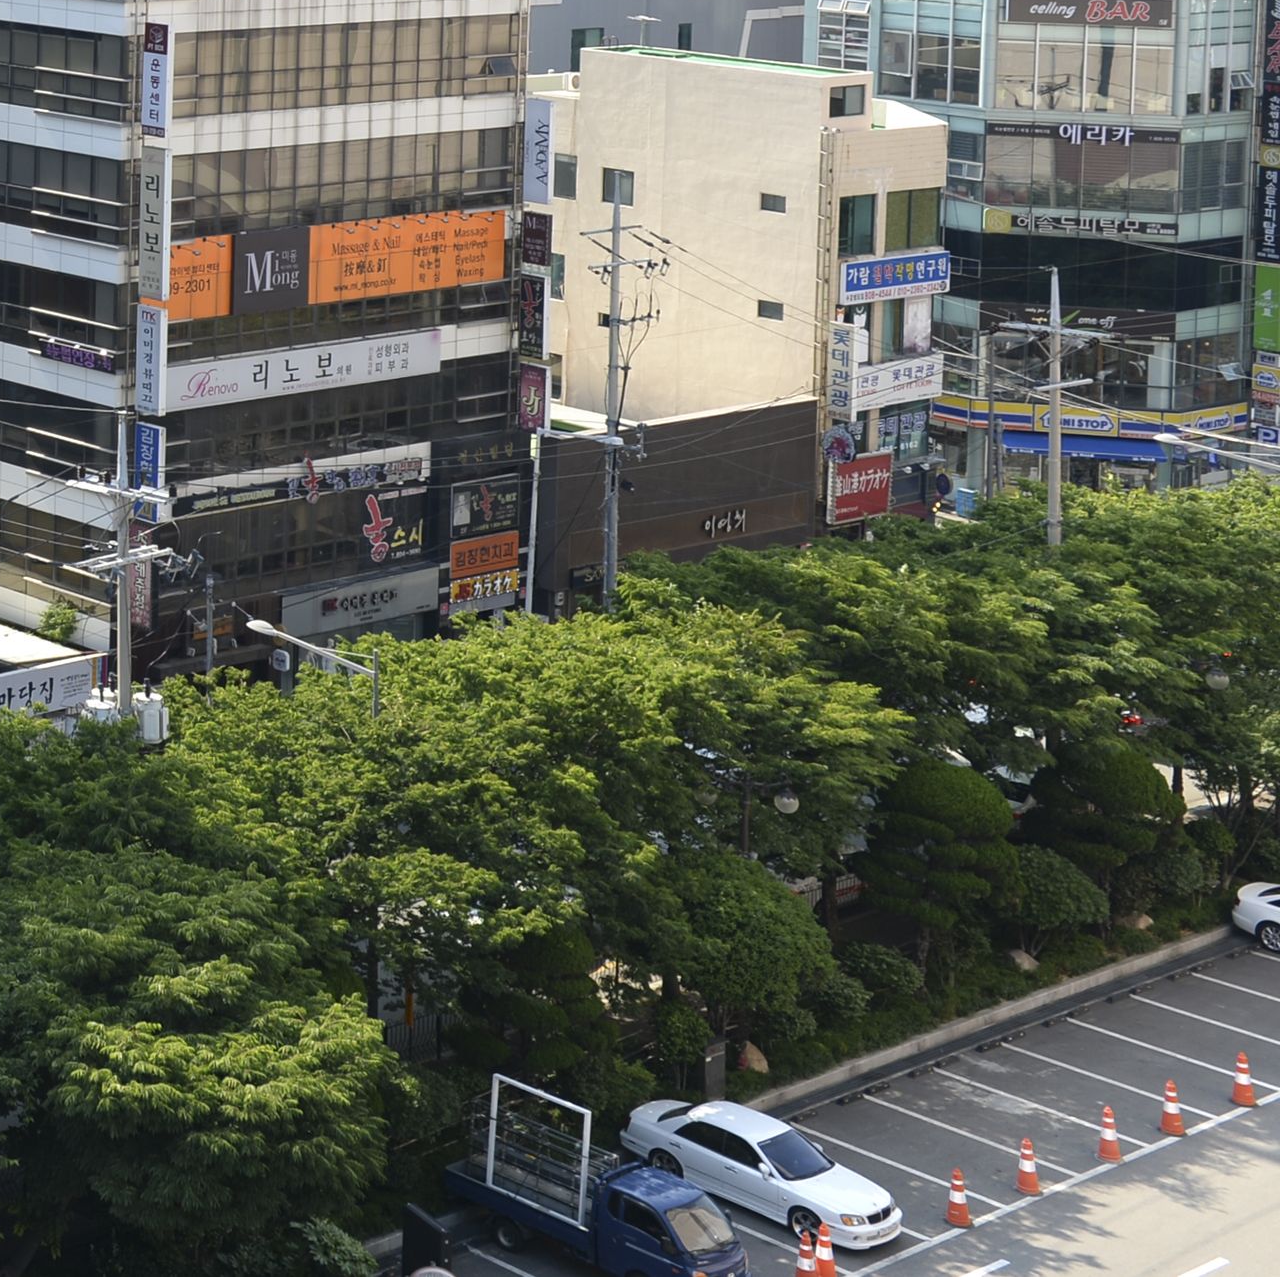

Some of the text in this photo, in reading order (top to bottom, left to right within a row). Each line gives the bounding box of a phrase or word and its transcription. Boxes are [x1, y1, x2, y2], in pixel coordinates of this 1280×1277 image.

[149, 58, 161, 123] 운동센터
[1058, 123, 1136, 147] 에리카
[143, 174, 161, 254] 리노보
[454, 227, 489, 240] Massage
[331, 240, 371, 257] Massage
[382, 235, 401, 250] Nail
[455, 253, 486, 267] Eyelash
[375, 342, 409, 359] 성형외과
[252, 352, 334, 390] 리노보
[375, 357, 409, 375] 피부과
[831, 328, 850, 408] 롯데관광
[180, 368, 239, 402] Renovo
[1077, 416, 1108, 429] STOP
[1258, 427, 1276, 443] P
[455, 541, 515, 567] 김장현치과
[473, 575, 513, 597] カラオケ
